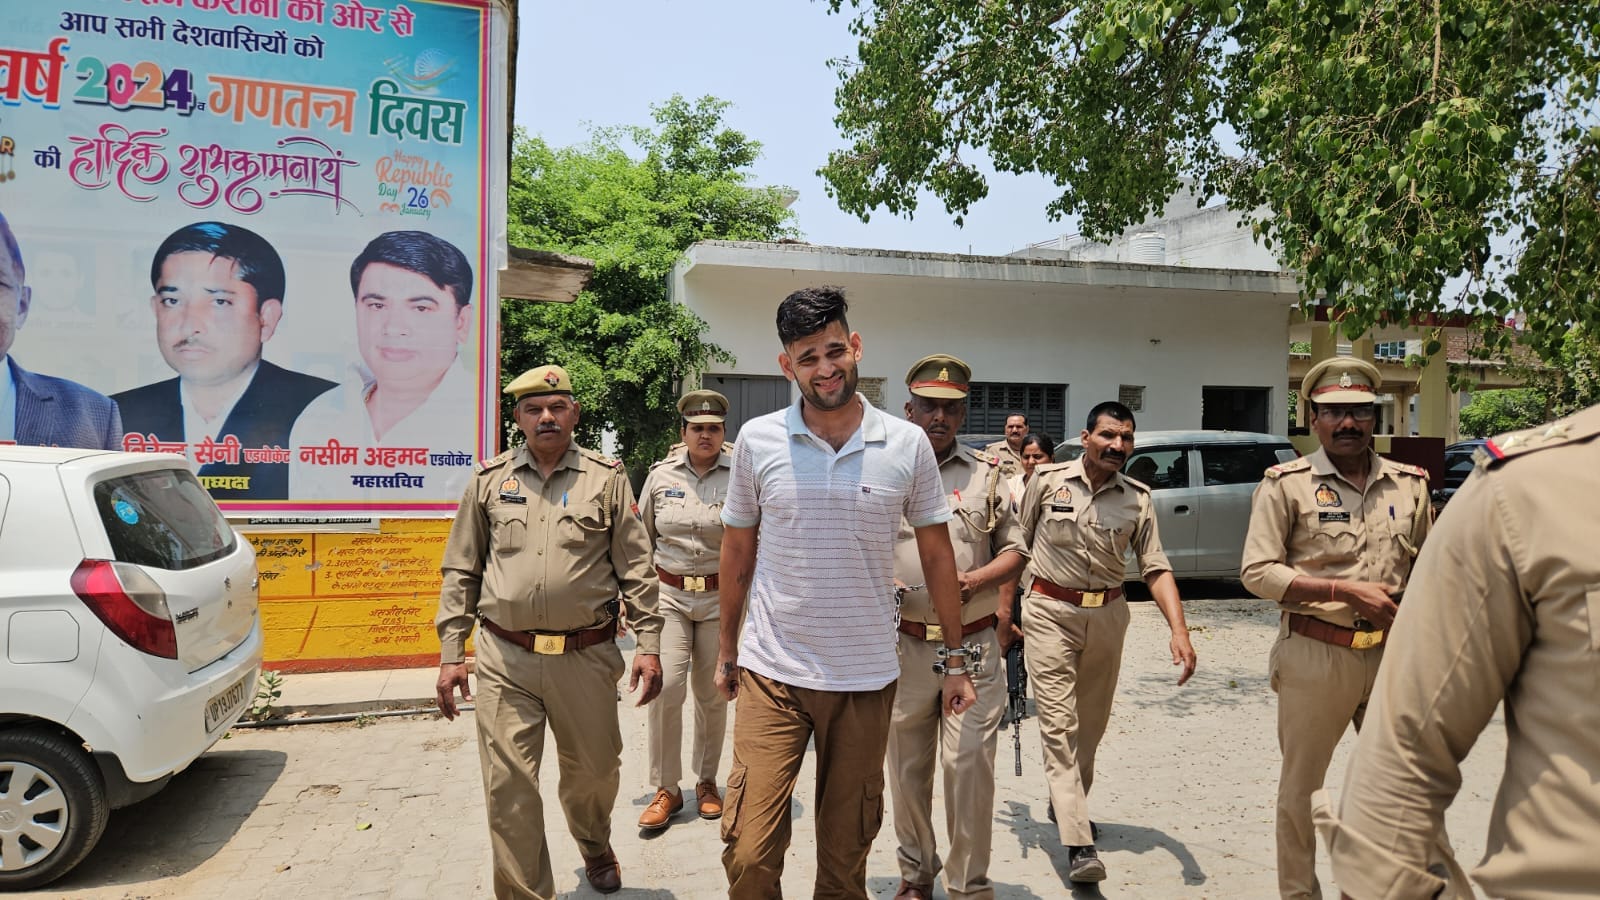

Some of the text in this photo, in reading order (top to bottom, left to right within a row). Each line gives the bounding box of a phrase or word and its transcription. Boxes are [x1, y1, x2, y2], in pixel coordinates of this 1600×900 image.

[332, 1, 384, 32] ओर
[390, 7, 414, 35] से
[60, 12, 325, 58] आप सभी देशवासियों को
[74, 57, 193, 110] 2024
[208, 76, 357, 133] गणतन्त्र
[369, 79, 466, 144] दिवस
[33, 145, 61, 169] की
[376, 156, 454, 192] Republic
[378, 182, 429, 208] Day 26
[400, 203, 431, 220] January
[194, 436, 240, 464] सैनी
[244, 445, 291, 464] एडवोकेट
[299, 438, 472, 468] नसीम अहमद एडवोकेट
[350, 472, 424, 488] महासचिव
